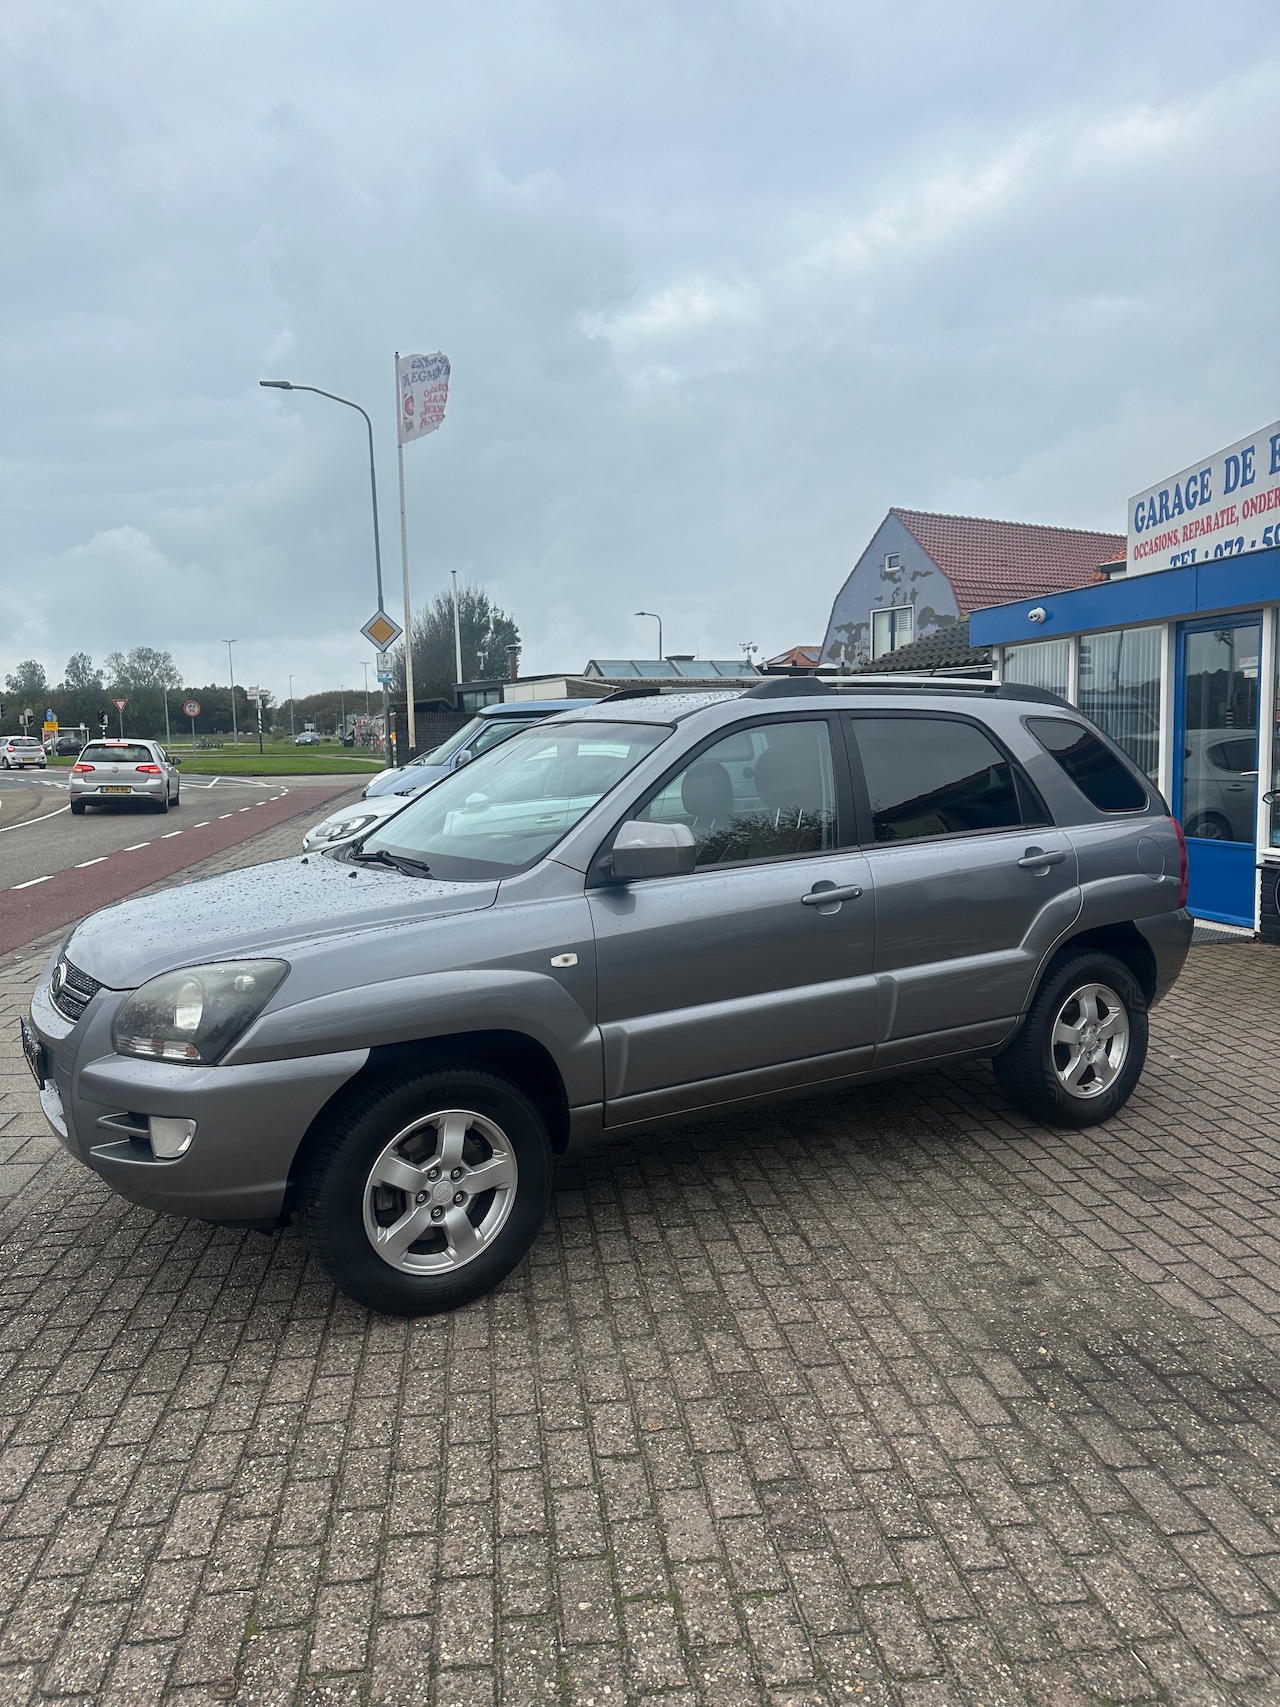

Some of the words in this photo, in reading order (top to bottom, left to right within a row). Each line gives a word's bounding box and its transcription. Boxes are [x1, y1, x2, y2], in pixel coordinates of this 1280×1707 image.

[1134, 467, 1212, 533] GARAGE
[1223, 445, 1256, 495] DE
[1133, 528, 1181, 561] OCCASIONS,
[1182, 504, 1239, 543] REPARATIE,
